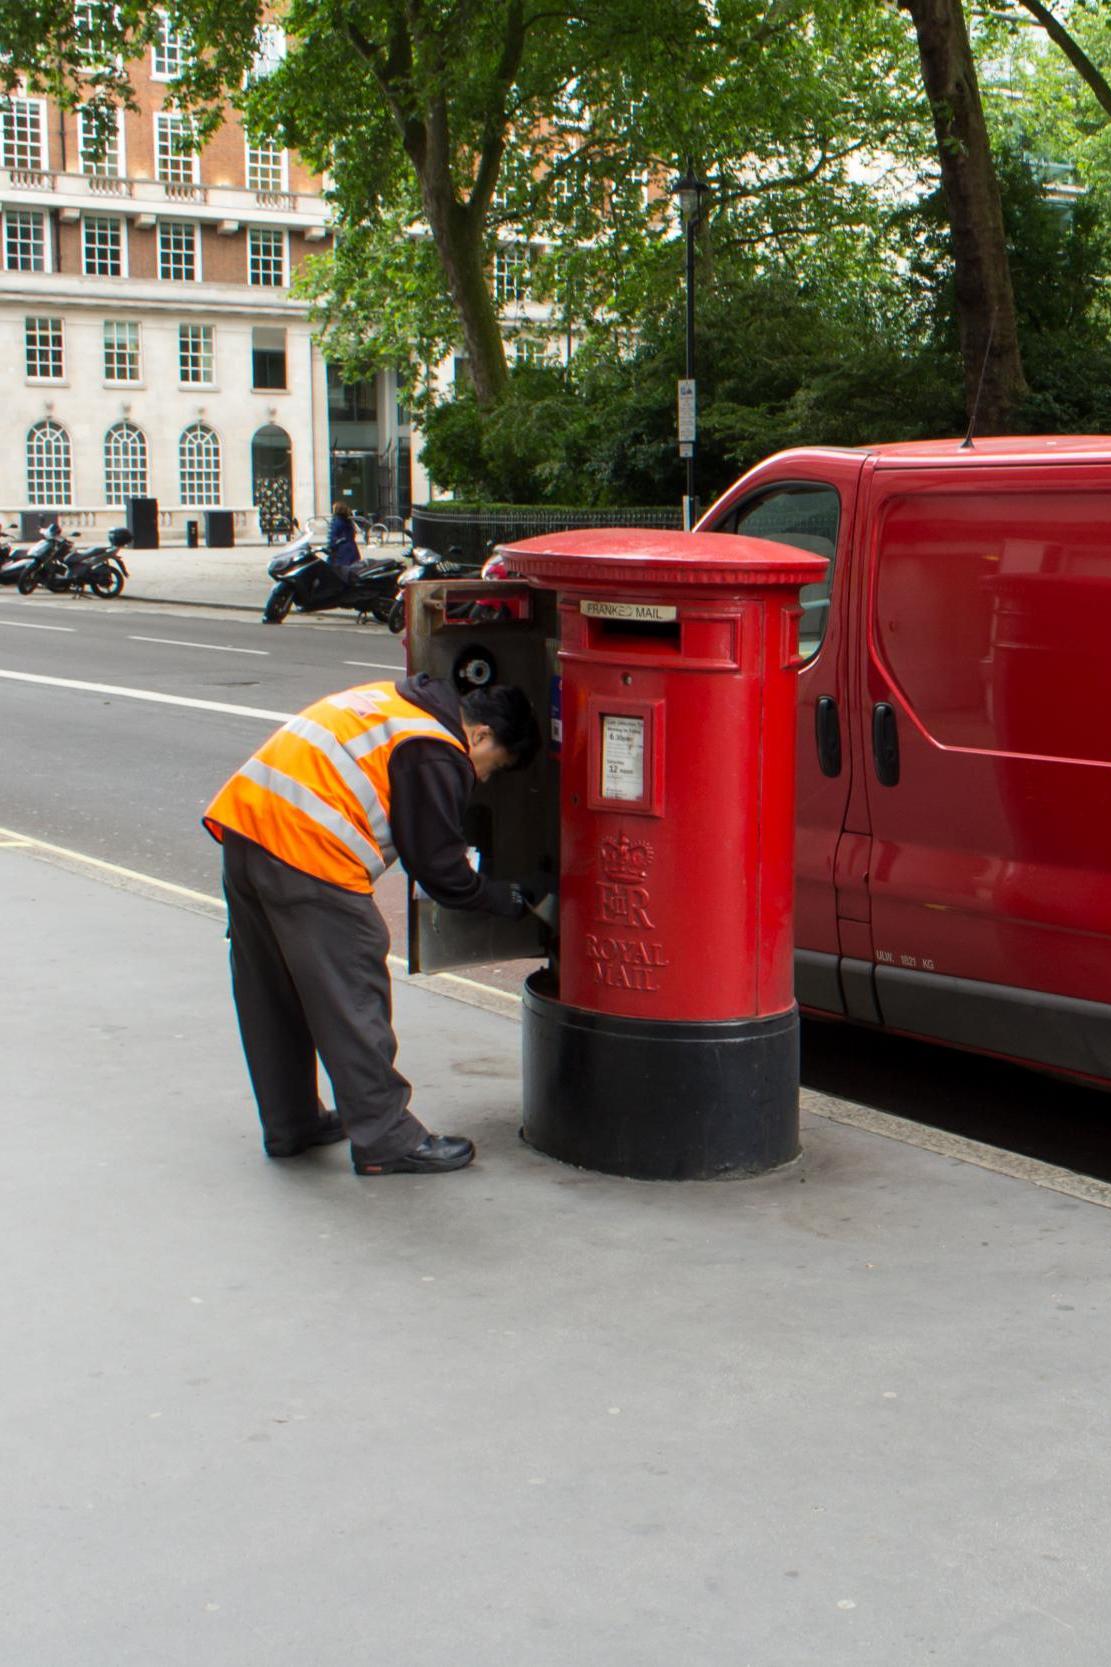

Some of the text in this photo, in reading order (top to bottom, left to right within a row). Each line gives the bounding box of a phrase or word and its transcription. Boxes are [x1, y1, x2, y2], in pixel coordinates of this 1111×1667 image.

[586, 602, 663, 619] FRANKED MAIL
[586, 934, 669, 967] ROYAL
[595, 962, 661, 991] MAIL
